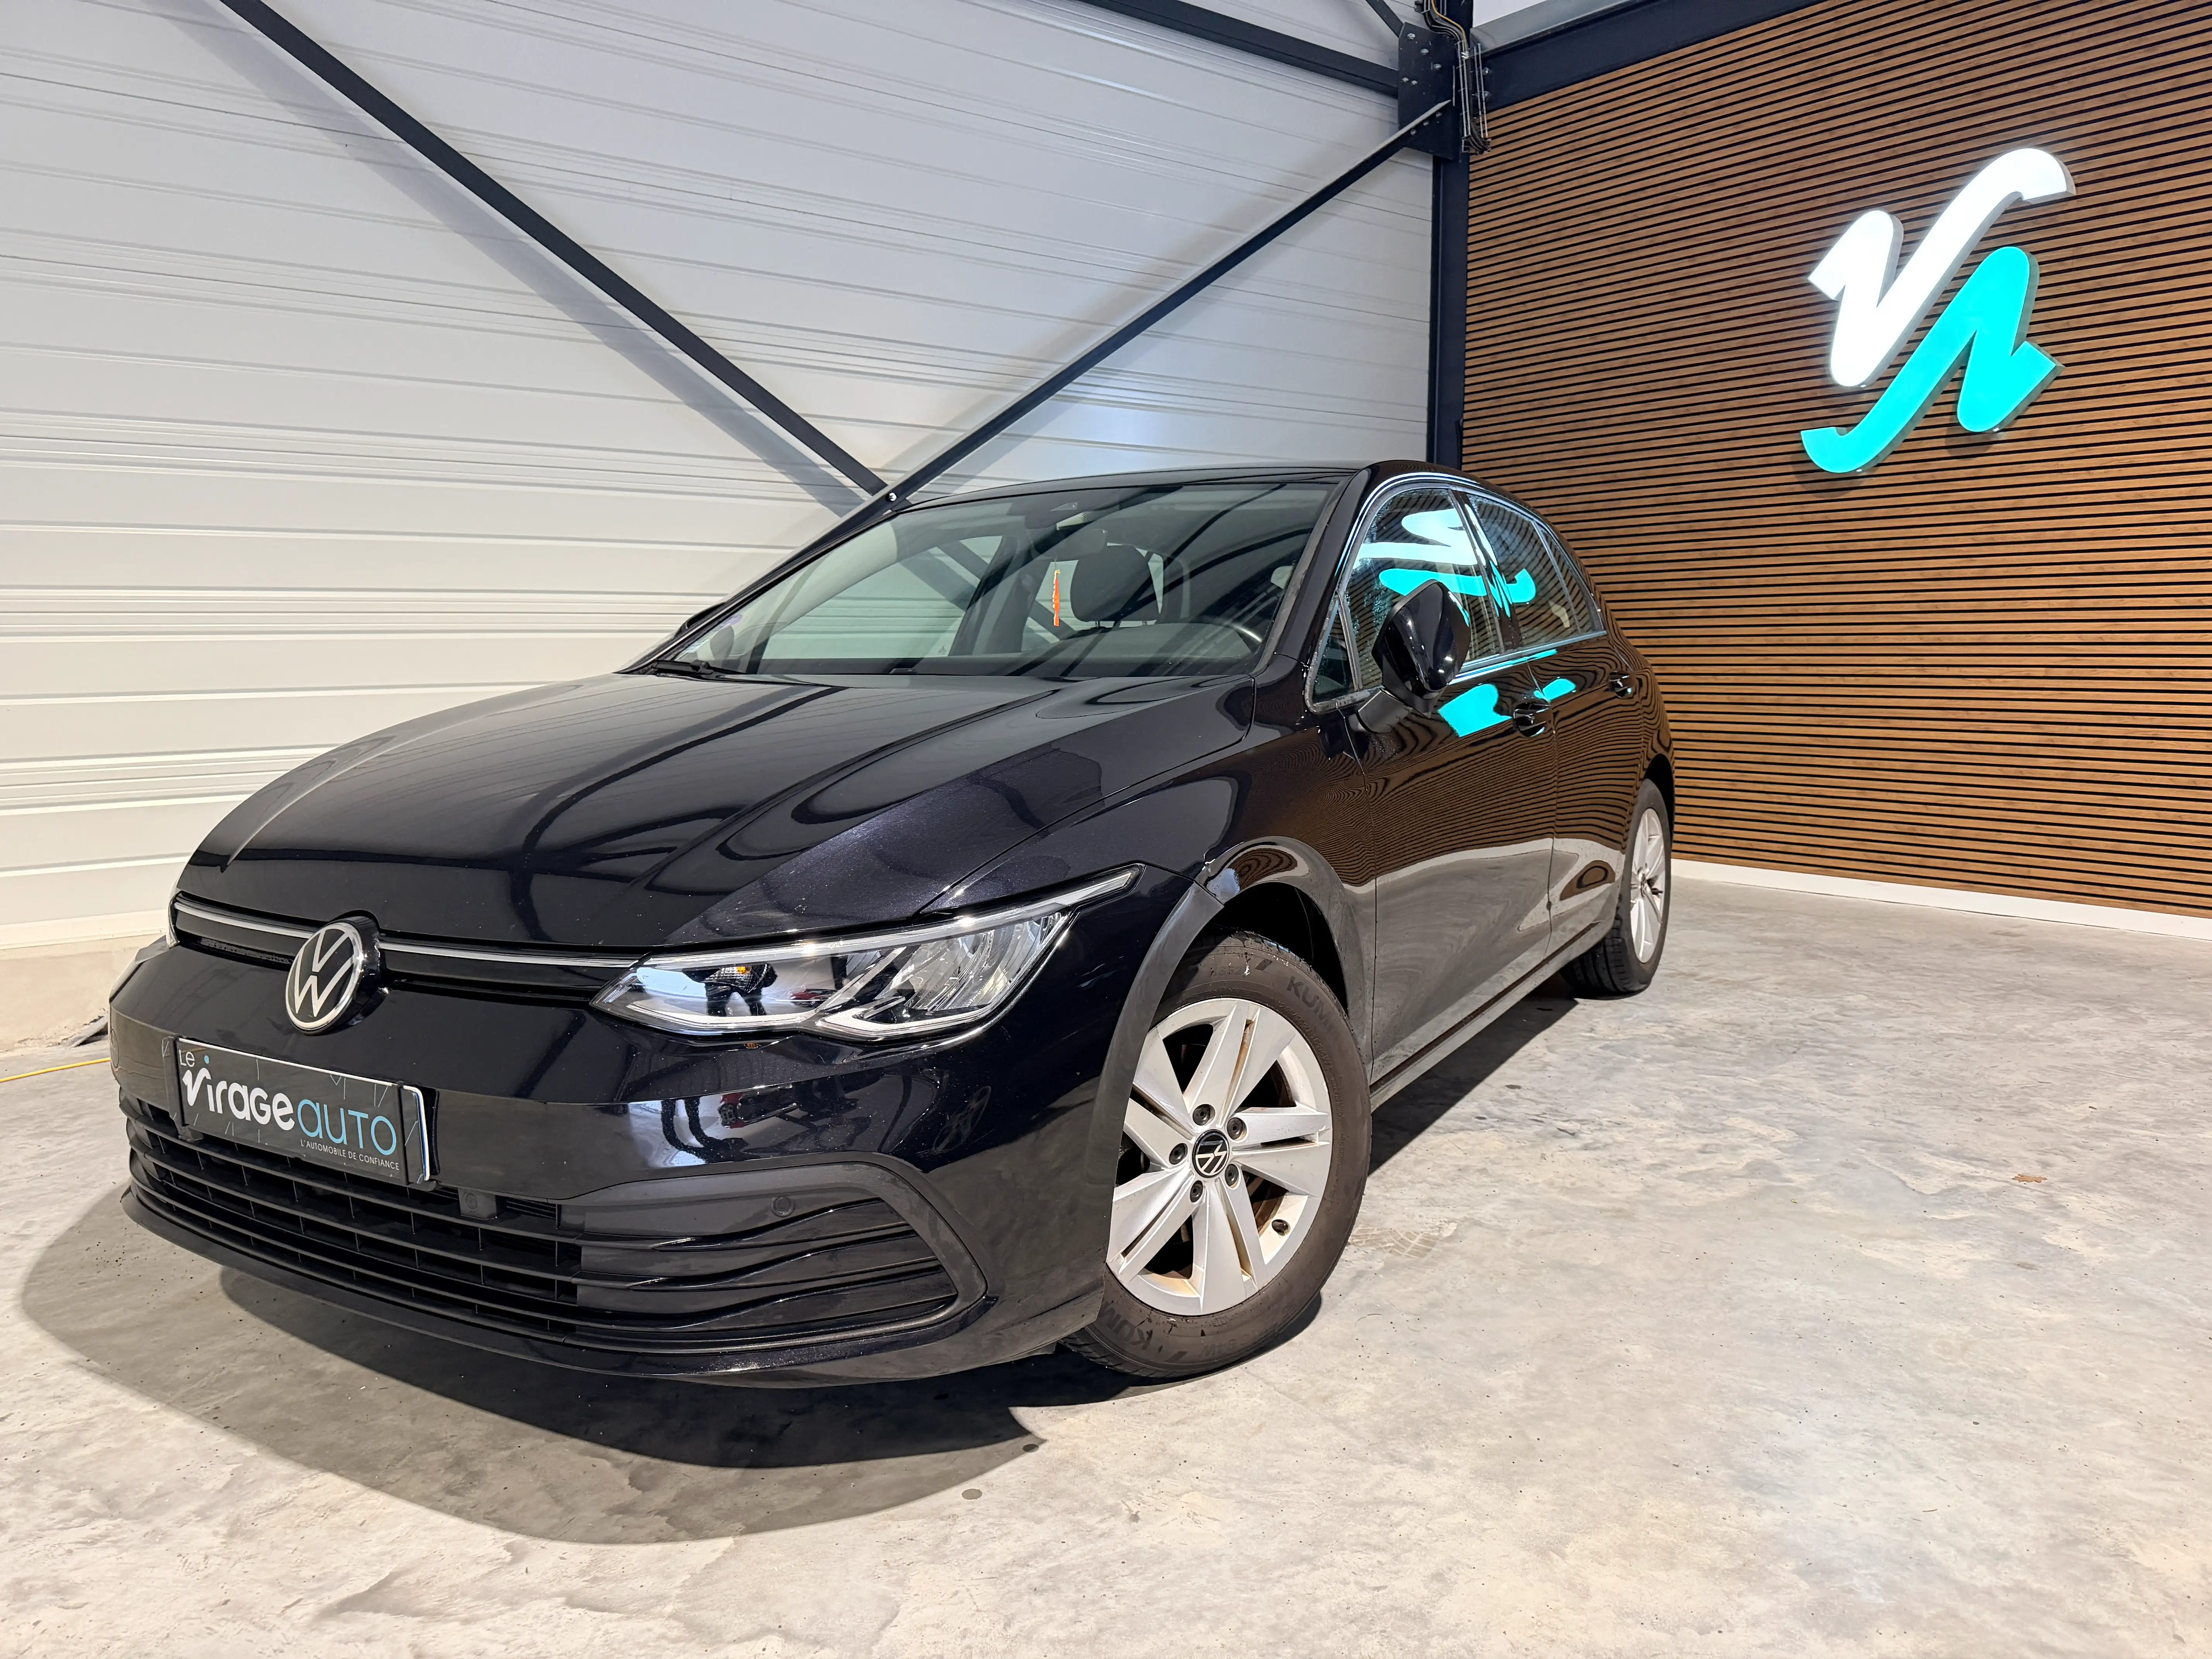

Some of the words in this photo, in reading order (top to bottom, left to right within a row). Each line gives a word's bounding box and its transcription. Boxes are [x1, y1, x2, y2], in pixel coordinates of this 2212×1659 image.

[179, 1049, 195, 1067] Le
[301, 1139, 346, 1158] L'AUTOMOBILE
[348, 1151, 357, 1160] DE
[359, 1154, 400, 1171] CONFIANCE
